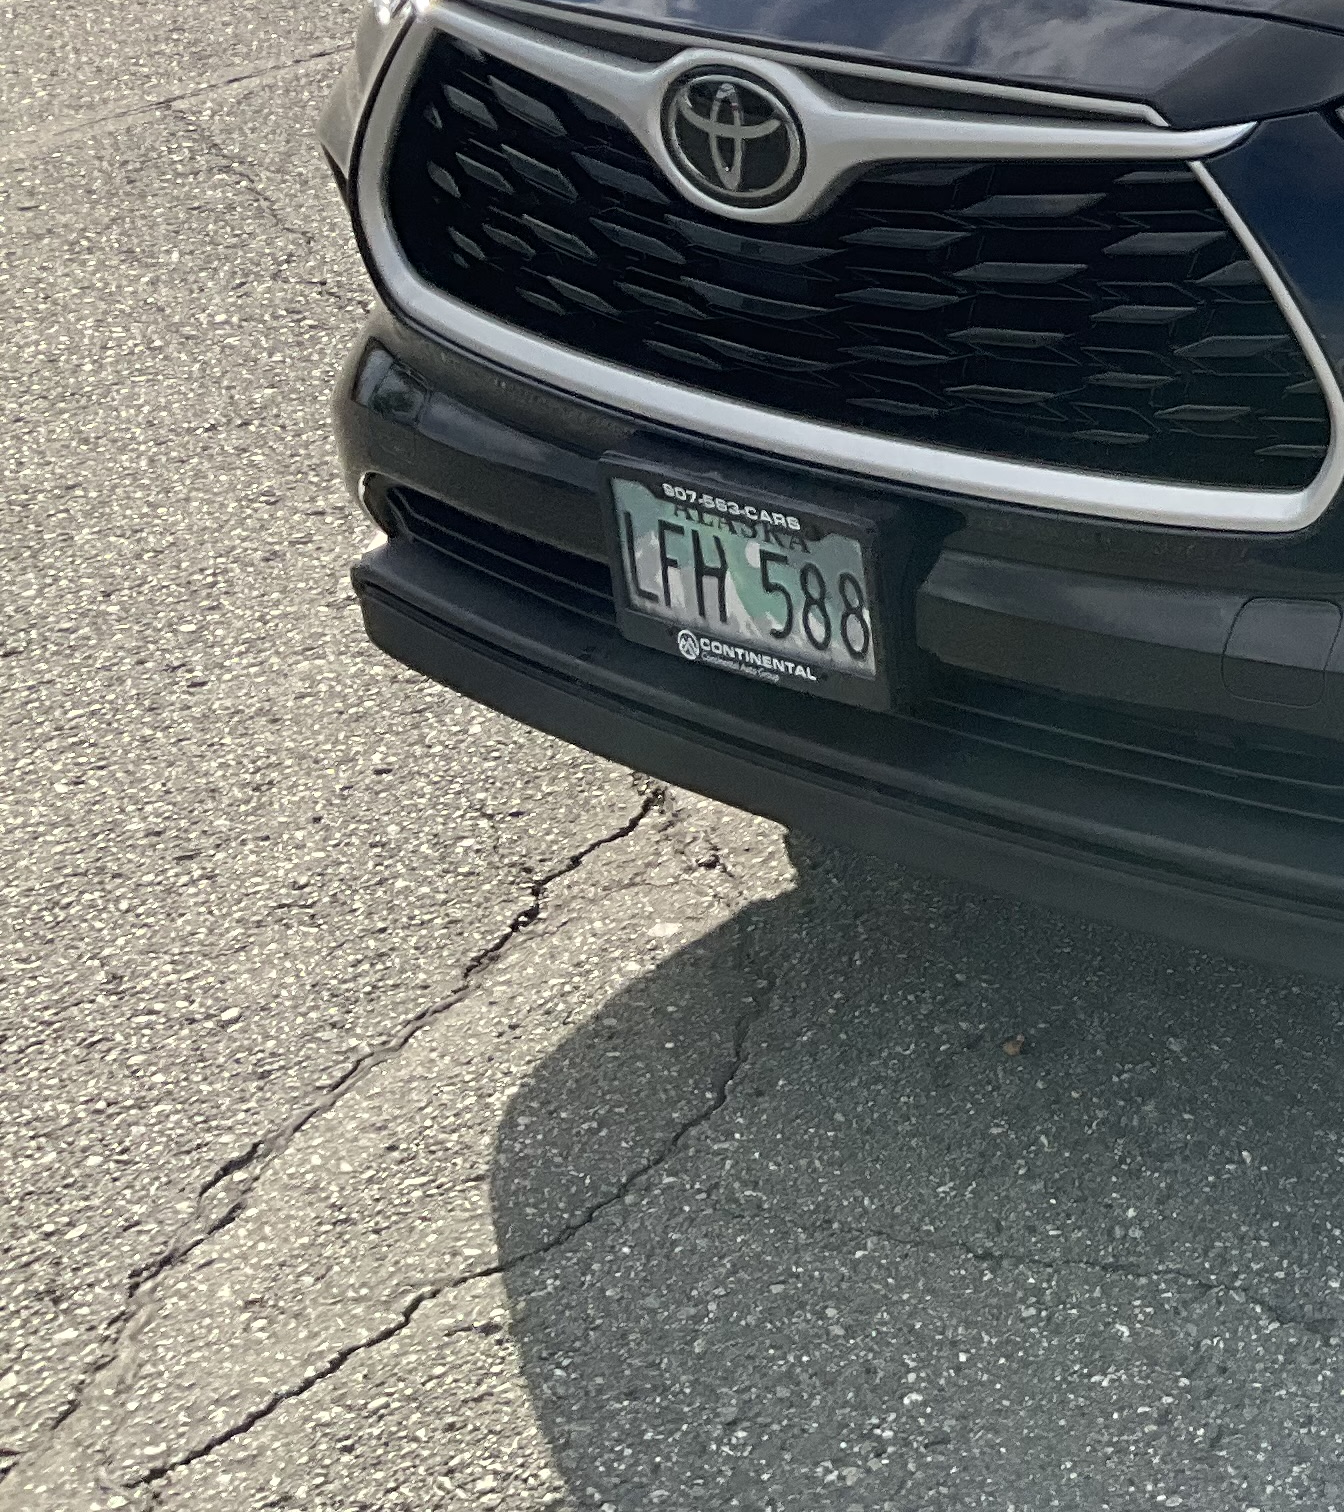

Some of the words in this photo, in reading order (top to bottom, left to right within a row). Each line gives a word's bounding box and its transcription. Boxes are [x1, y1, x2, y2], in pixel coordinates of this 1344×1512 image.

[623, 510, 728, 625] LFH
[759, 548, 870, 660] 588
[700, 637, 818, 681] CONTINENTAL
